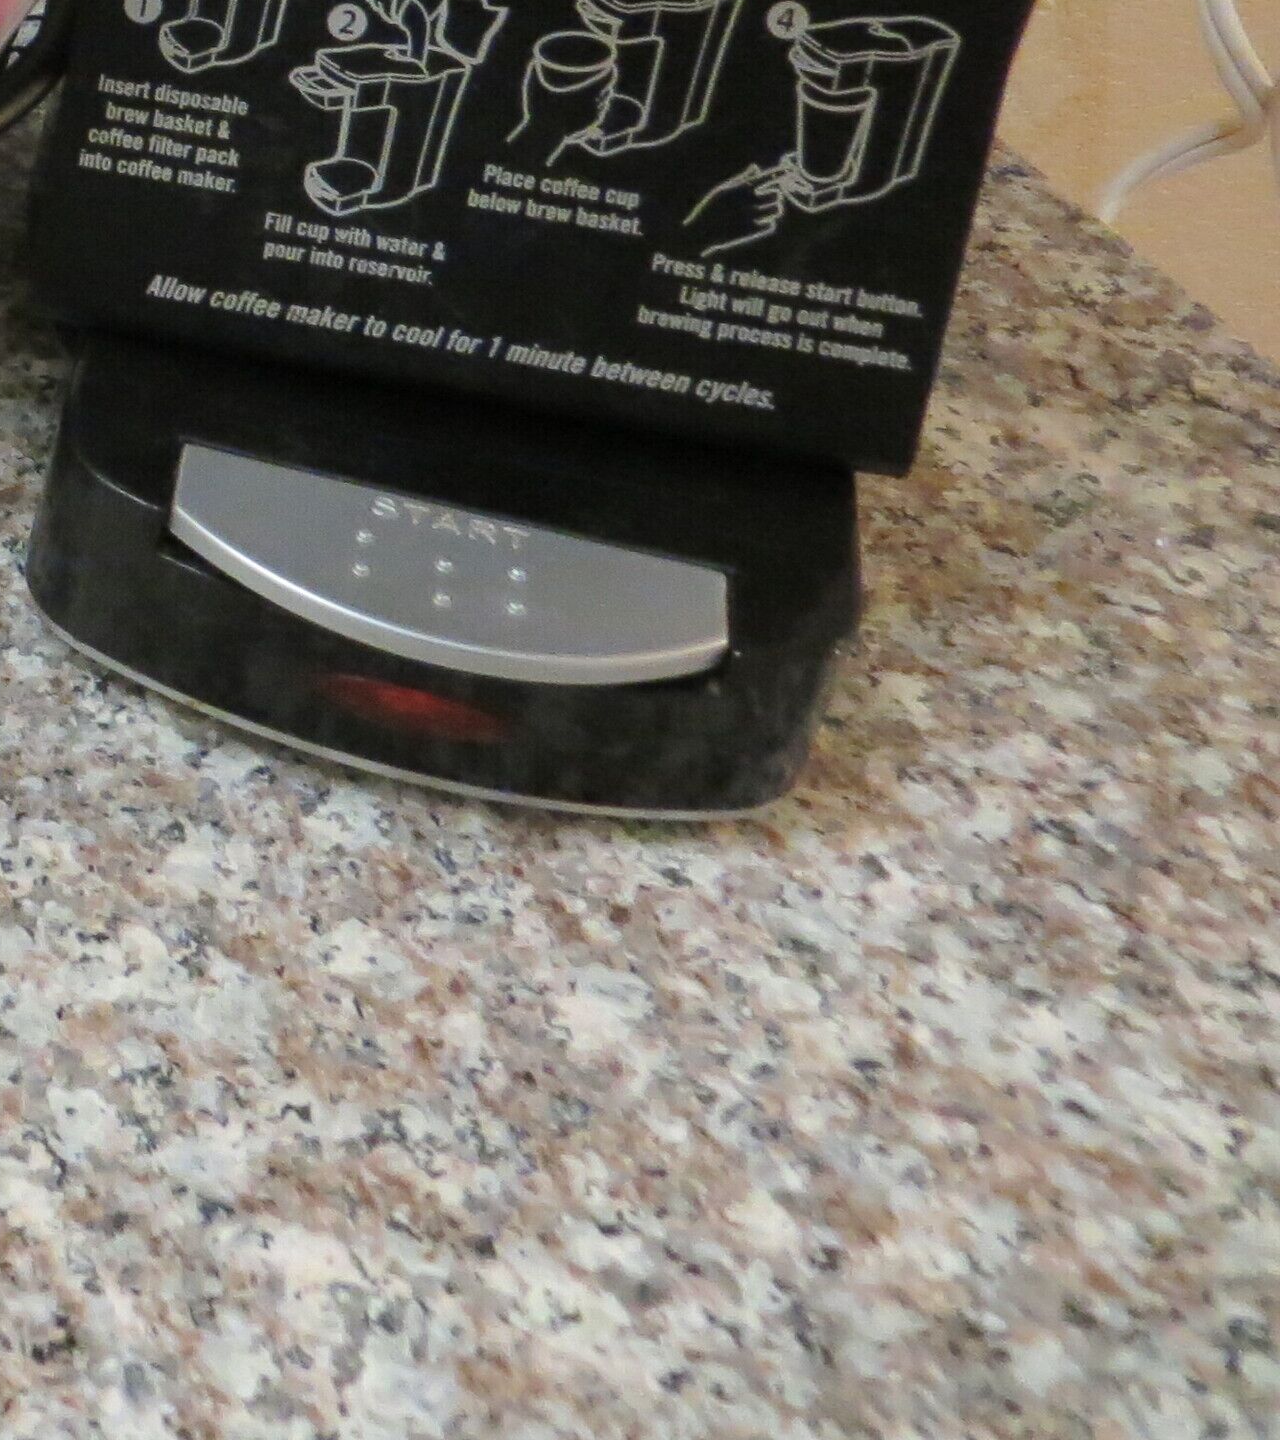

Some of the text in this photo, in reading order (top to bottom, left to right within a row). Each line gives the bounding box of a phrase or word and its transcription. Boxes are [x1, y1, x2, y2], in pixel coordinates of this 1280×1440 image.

[338, 9, 357, 35] 2
[775, 8, 796, 34] 4
[97, 74, 250, 116] Insert disposable
[106, 102, 230, 139] brew basket &
[88, 128, 240, 168] coffee filter pack
[79, 151, 237, 193] into coffee maker.
[483, 163, 641, 210] Place coffee cup
[467, 188, 644, 236] below brew basket.
[264, 211, 446, 261] Fill cup with water &
[263, 243, 433, 287] pour into reservoir.
[652, 252, 923, 319] Press & release start button.
[679, 286, 884, 339] Light will go out when
[146, 274, 775, 412] Allow coffee maker to cool for 1 minute between cycles.
[637, 307, 912, 372] brewing process is complete.
[370, 496, 532, 552] START
